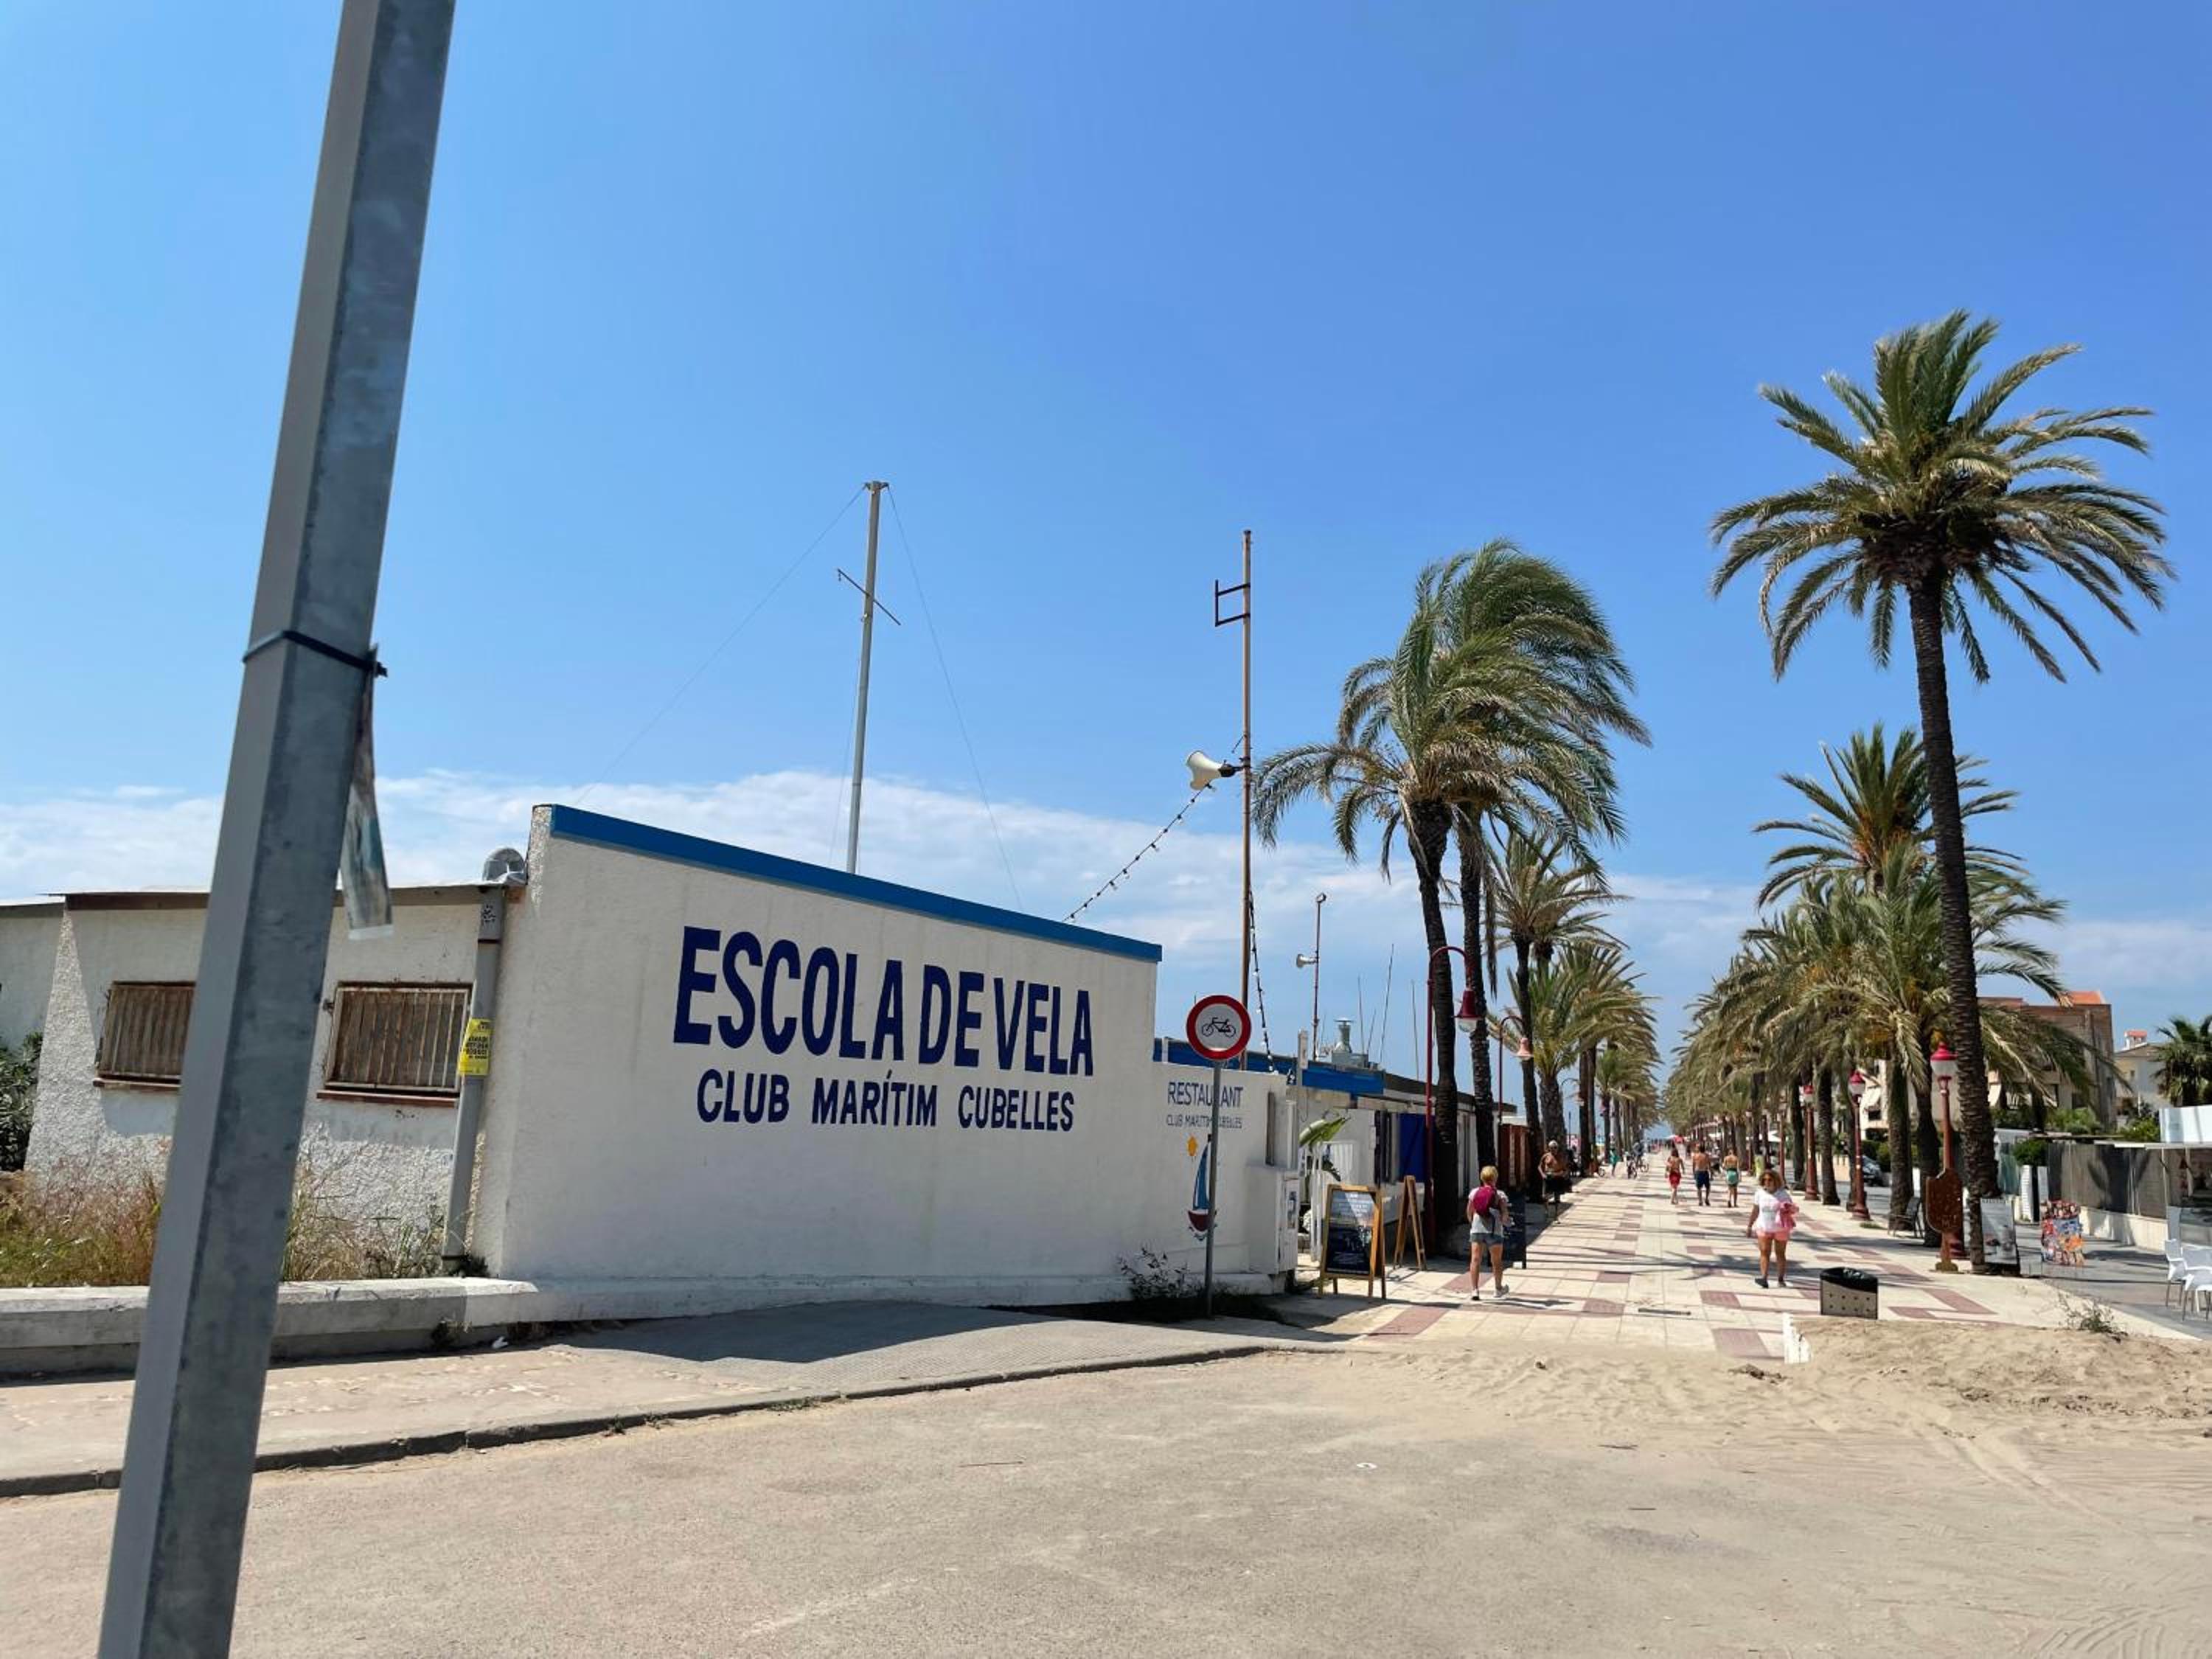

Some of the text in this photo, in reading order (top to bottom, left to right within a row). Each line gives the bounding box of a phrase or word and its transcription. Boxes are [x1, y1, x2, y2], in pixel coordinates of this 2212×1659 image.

[673, 925, 1094, 1077] ESCOLA DE VELA
[697, 1068, 1075, 1132] CLUB MARÍTIM CUBELLES
[1167, 1081, 1244, 1107] RESTAUANT
